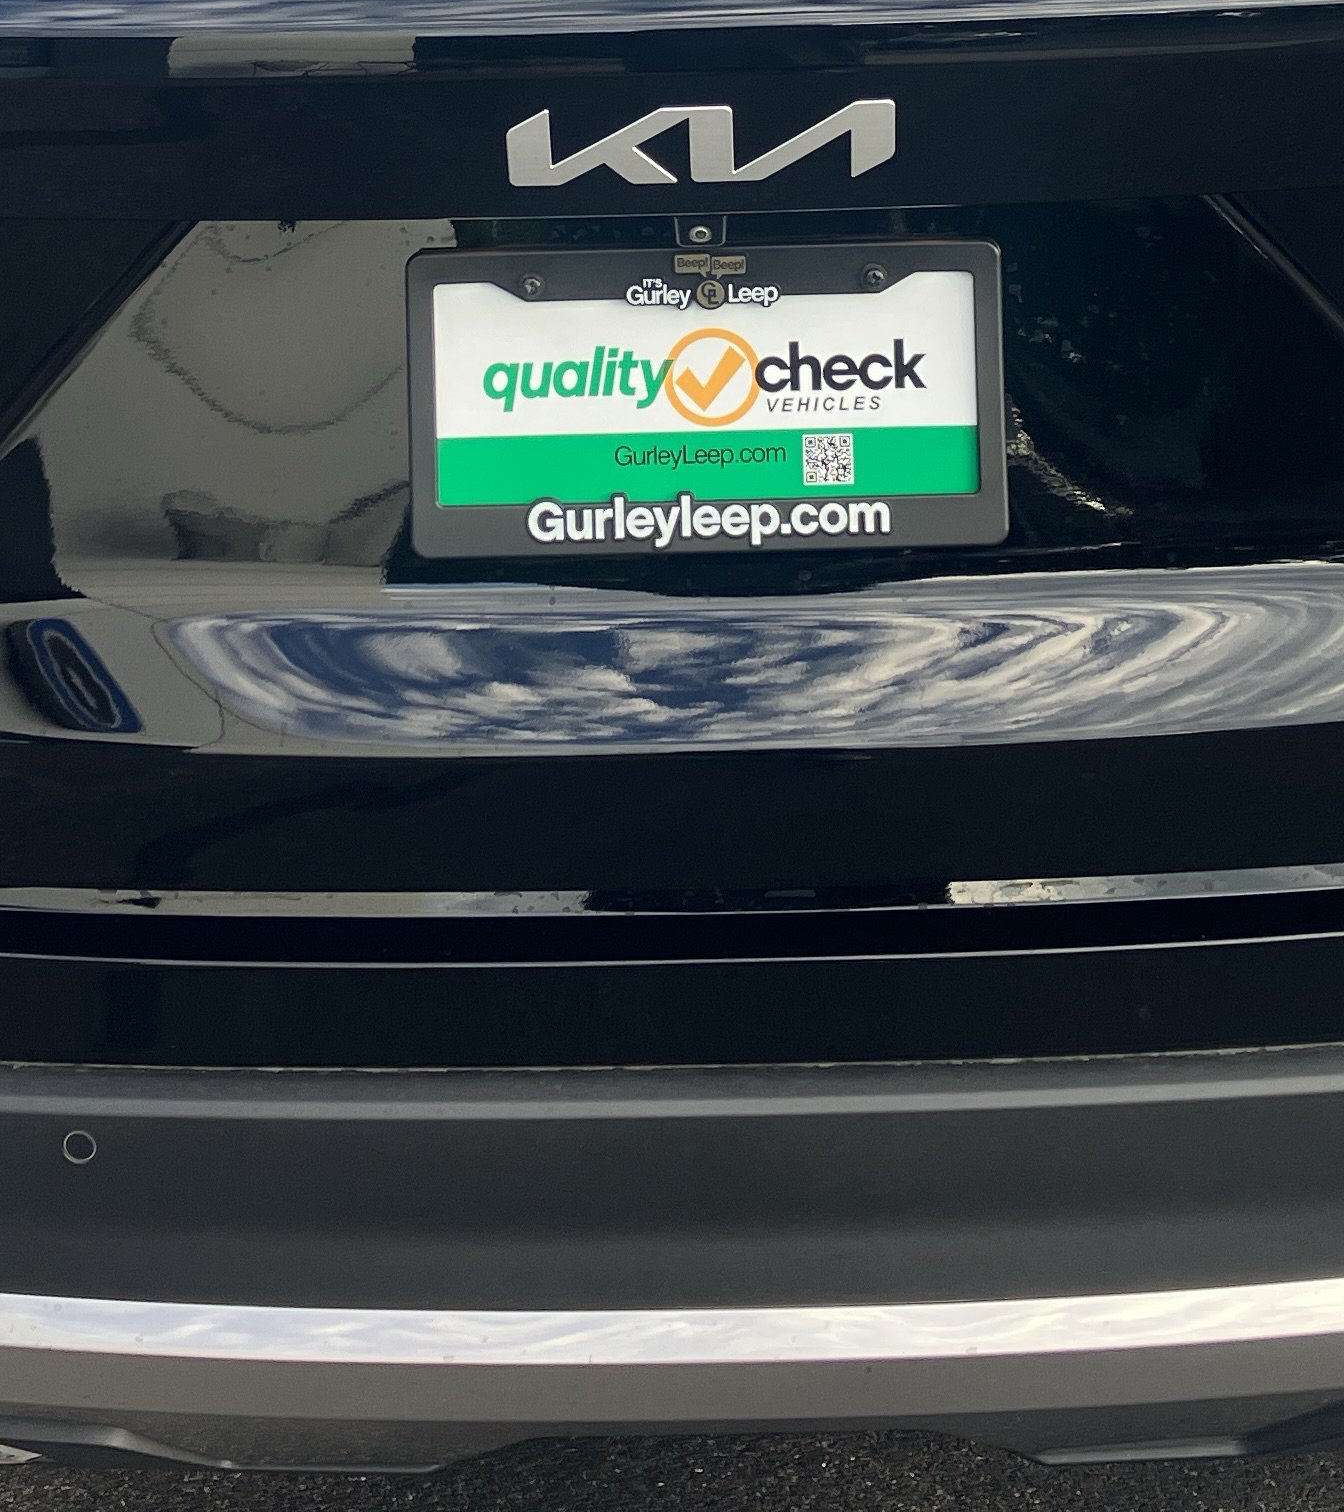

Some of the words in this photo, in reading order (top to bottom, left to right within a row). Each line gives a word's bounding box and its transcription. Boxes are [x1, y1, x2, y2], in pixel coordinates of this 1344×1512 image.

[506, 99, 896, 187] KIA
[677, 257, 708, 270] Beep!
[712, 260, 744, 271] Beep!
[626, 284, 691, 310] Gurley
[728, 283, 779, 306] Leep
[483, 346, 674, 412] quality
[755, 339, 927, 393] check
[766, 396, 881, 413] VEHICLES
[614, 445, 787, 470] GurleyLeep.com
[528, 495, 890, 548] Gurleyleep.com
